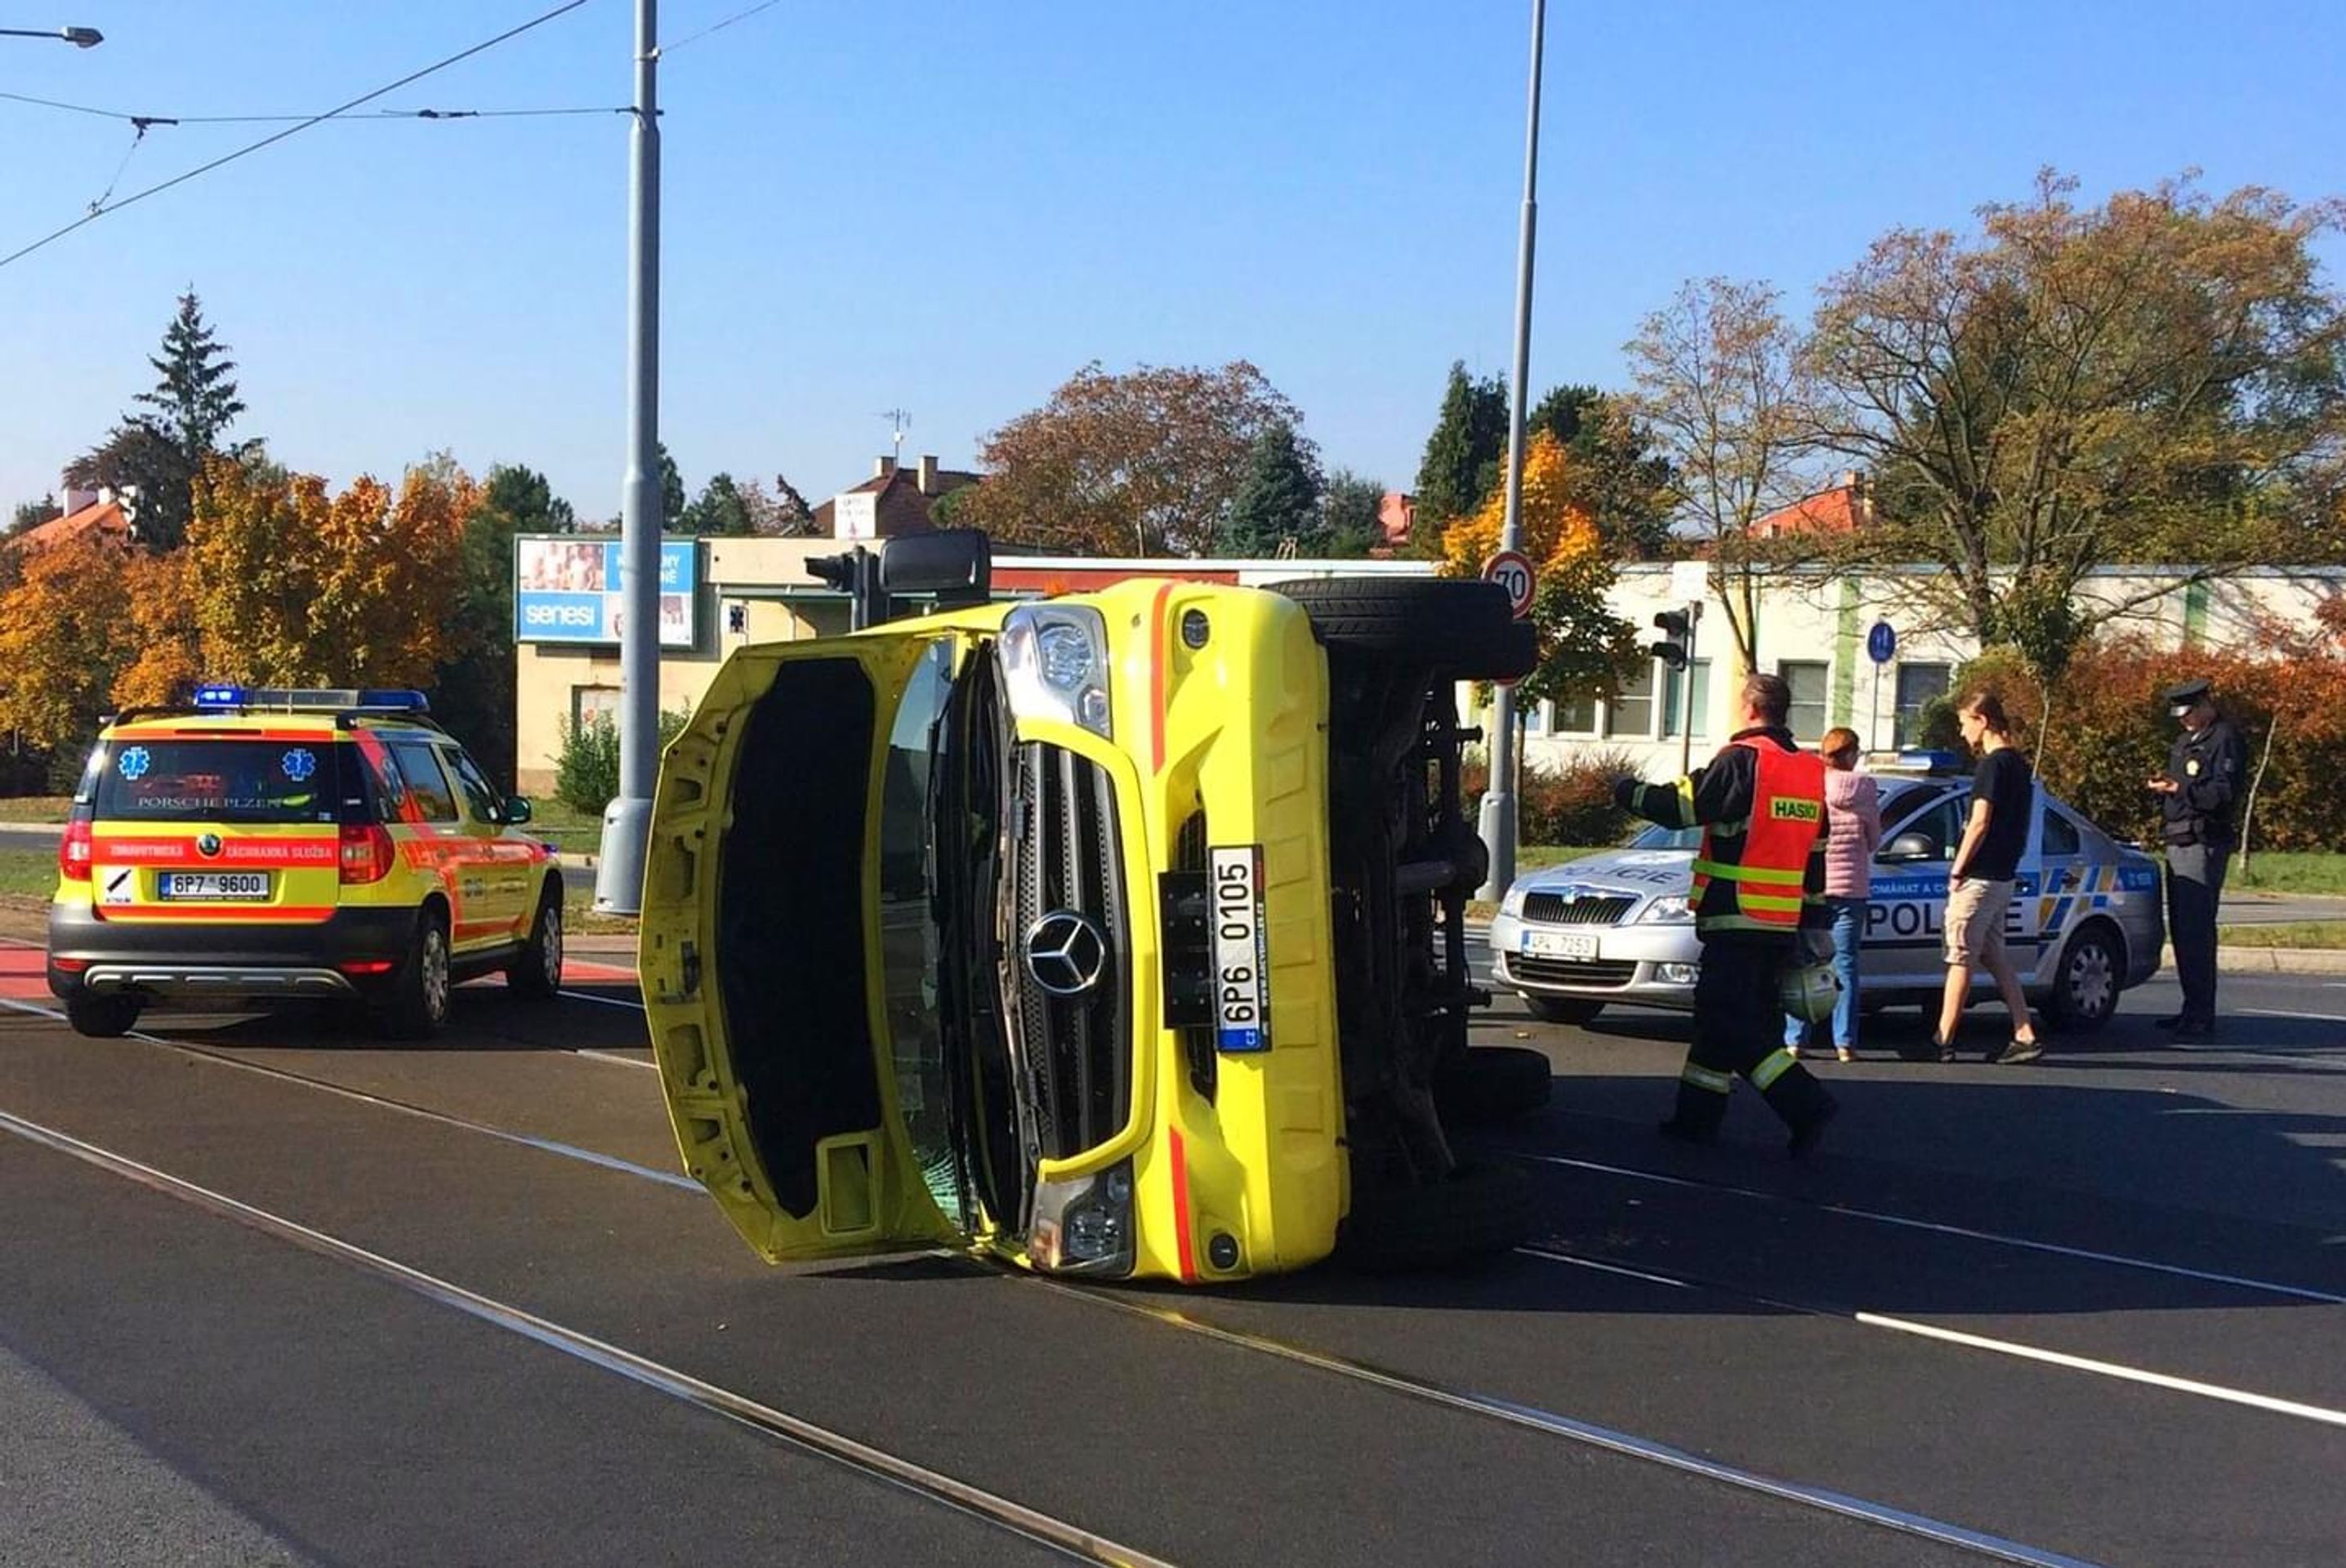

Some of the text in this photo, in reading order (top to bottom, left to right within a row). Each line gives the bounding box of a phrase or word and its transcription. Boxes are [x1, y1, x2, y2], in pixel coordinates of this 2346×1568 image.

[1496, 570, 1526, 601] 70
[525, 604, 594, 626] senesi
[138, 796, 219, 808] PORSCHE
[174, 875, 261, 893] 6P7 9600
[1865, 902, 2023, 936] POLE
[1218, 863, 1256, 1022] 6P6 0105
